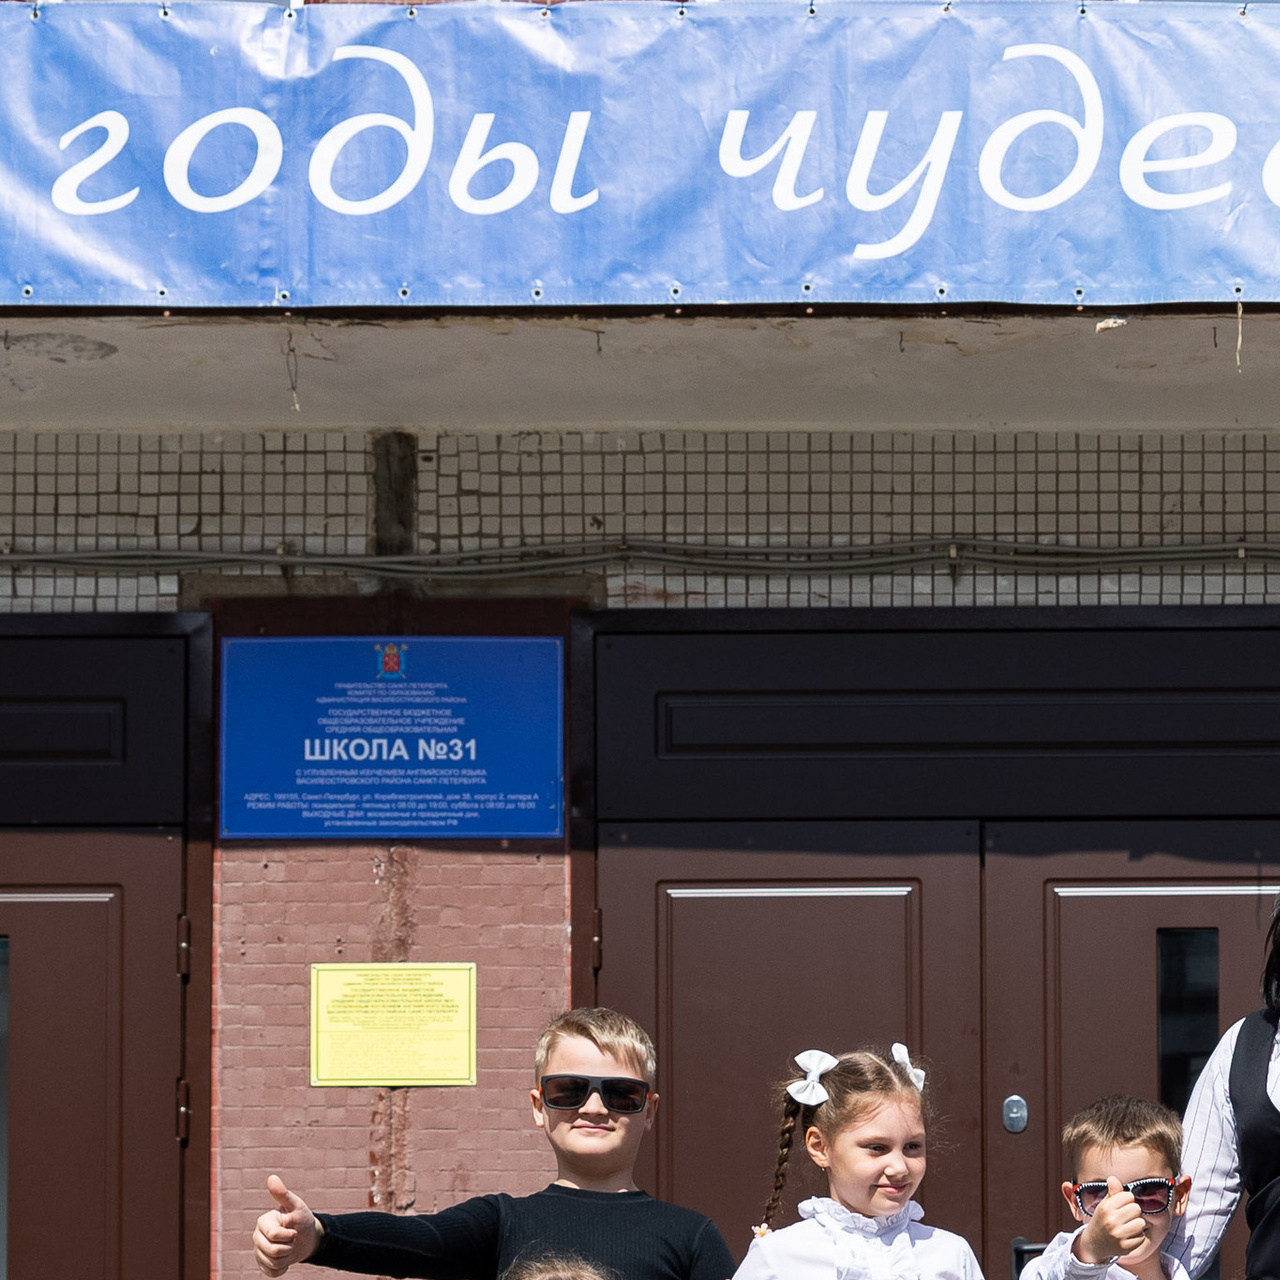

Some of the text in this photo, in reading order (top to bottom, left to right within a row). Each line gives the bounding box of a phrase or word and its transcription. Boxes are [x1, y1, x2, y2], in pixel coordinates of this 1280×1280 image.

[50, 45, 599, 216] годы
[328, 708, 452, 716] ГОСУДАРСТВЕННОЕ БЮДЖЕТНОЕ
[304, 738, 477, 761] ШКОЛА №31
